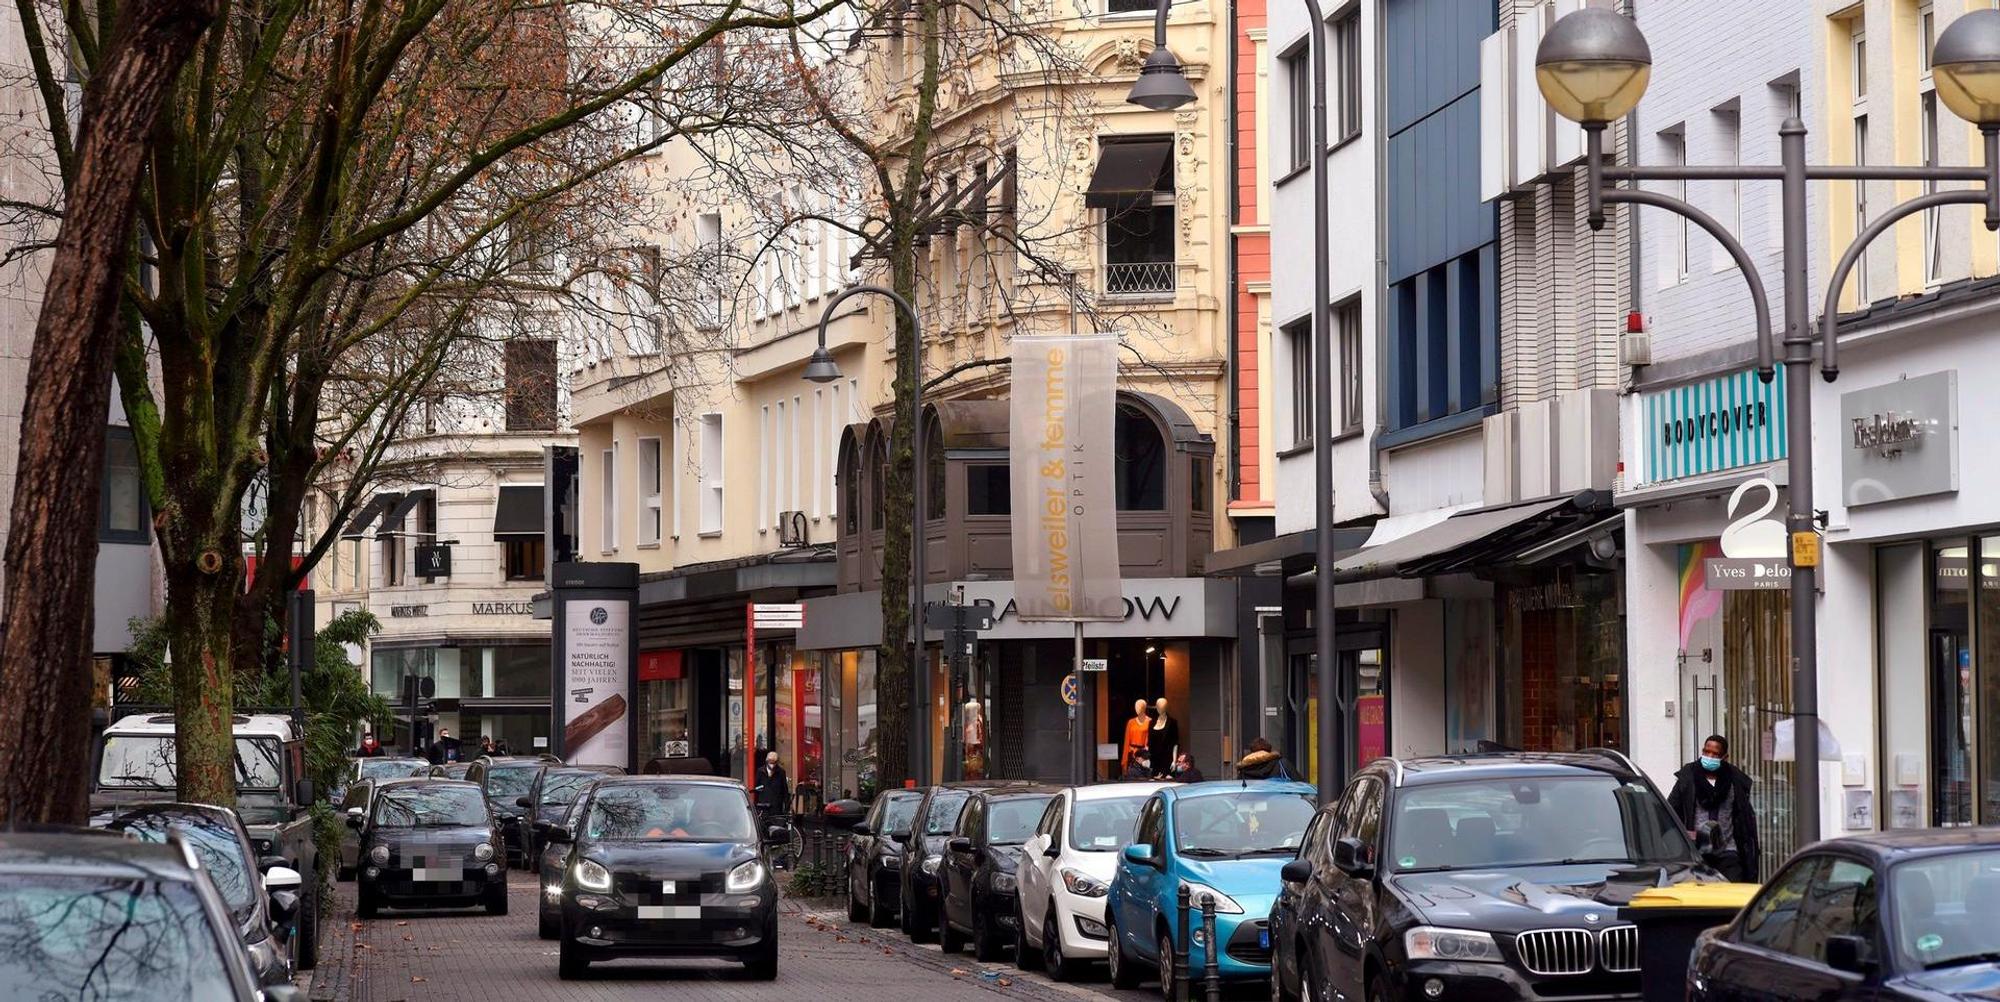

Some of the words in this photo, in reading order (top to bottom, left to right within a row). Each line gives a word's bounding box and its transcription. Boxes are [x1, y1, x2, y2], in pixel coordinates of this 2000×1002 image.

[1041, 347, 1067, 451] temme
[1664, 401, 1766, 447] BODYCOVER
[1041, 458, 1066, 480] &
[1073, 443, 1085, 516] OPTIK
[1713, 563, 1746, 578] Yves
[472, 602, 534, 615] MARKUS
[571, 652, 609, 660] NATÜRLICH
[571, 660, 616, 668] NACHHALTIG!
